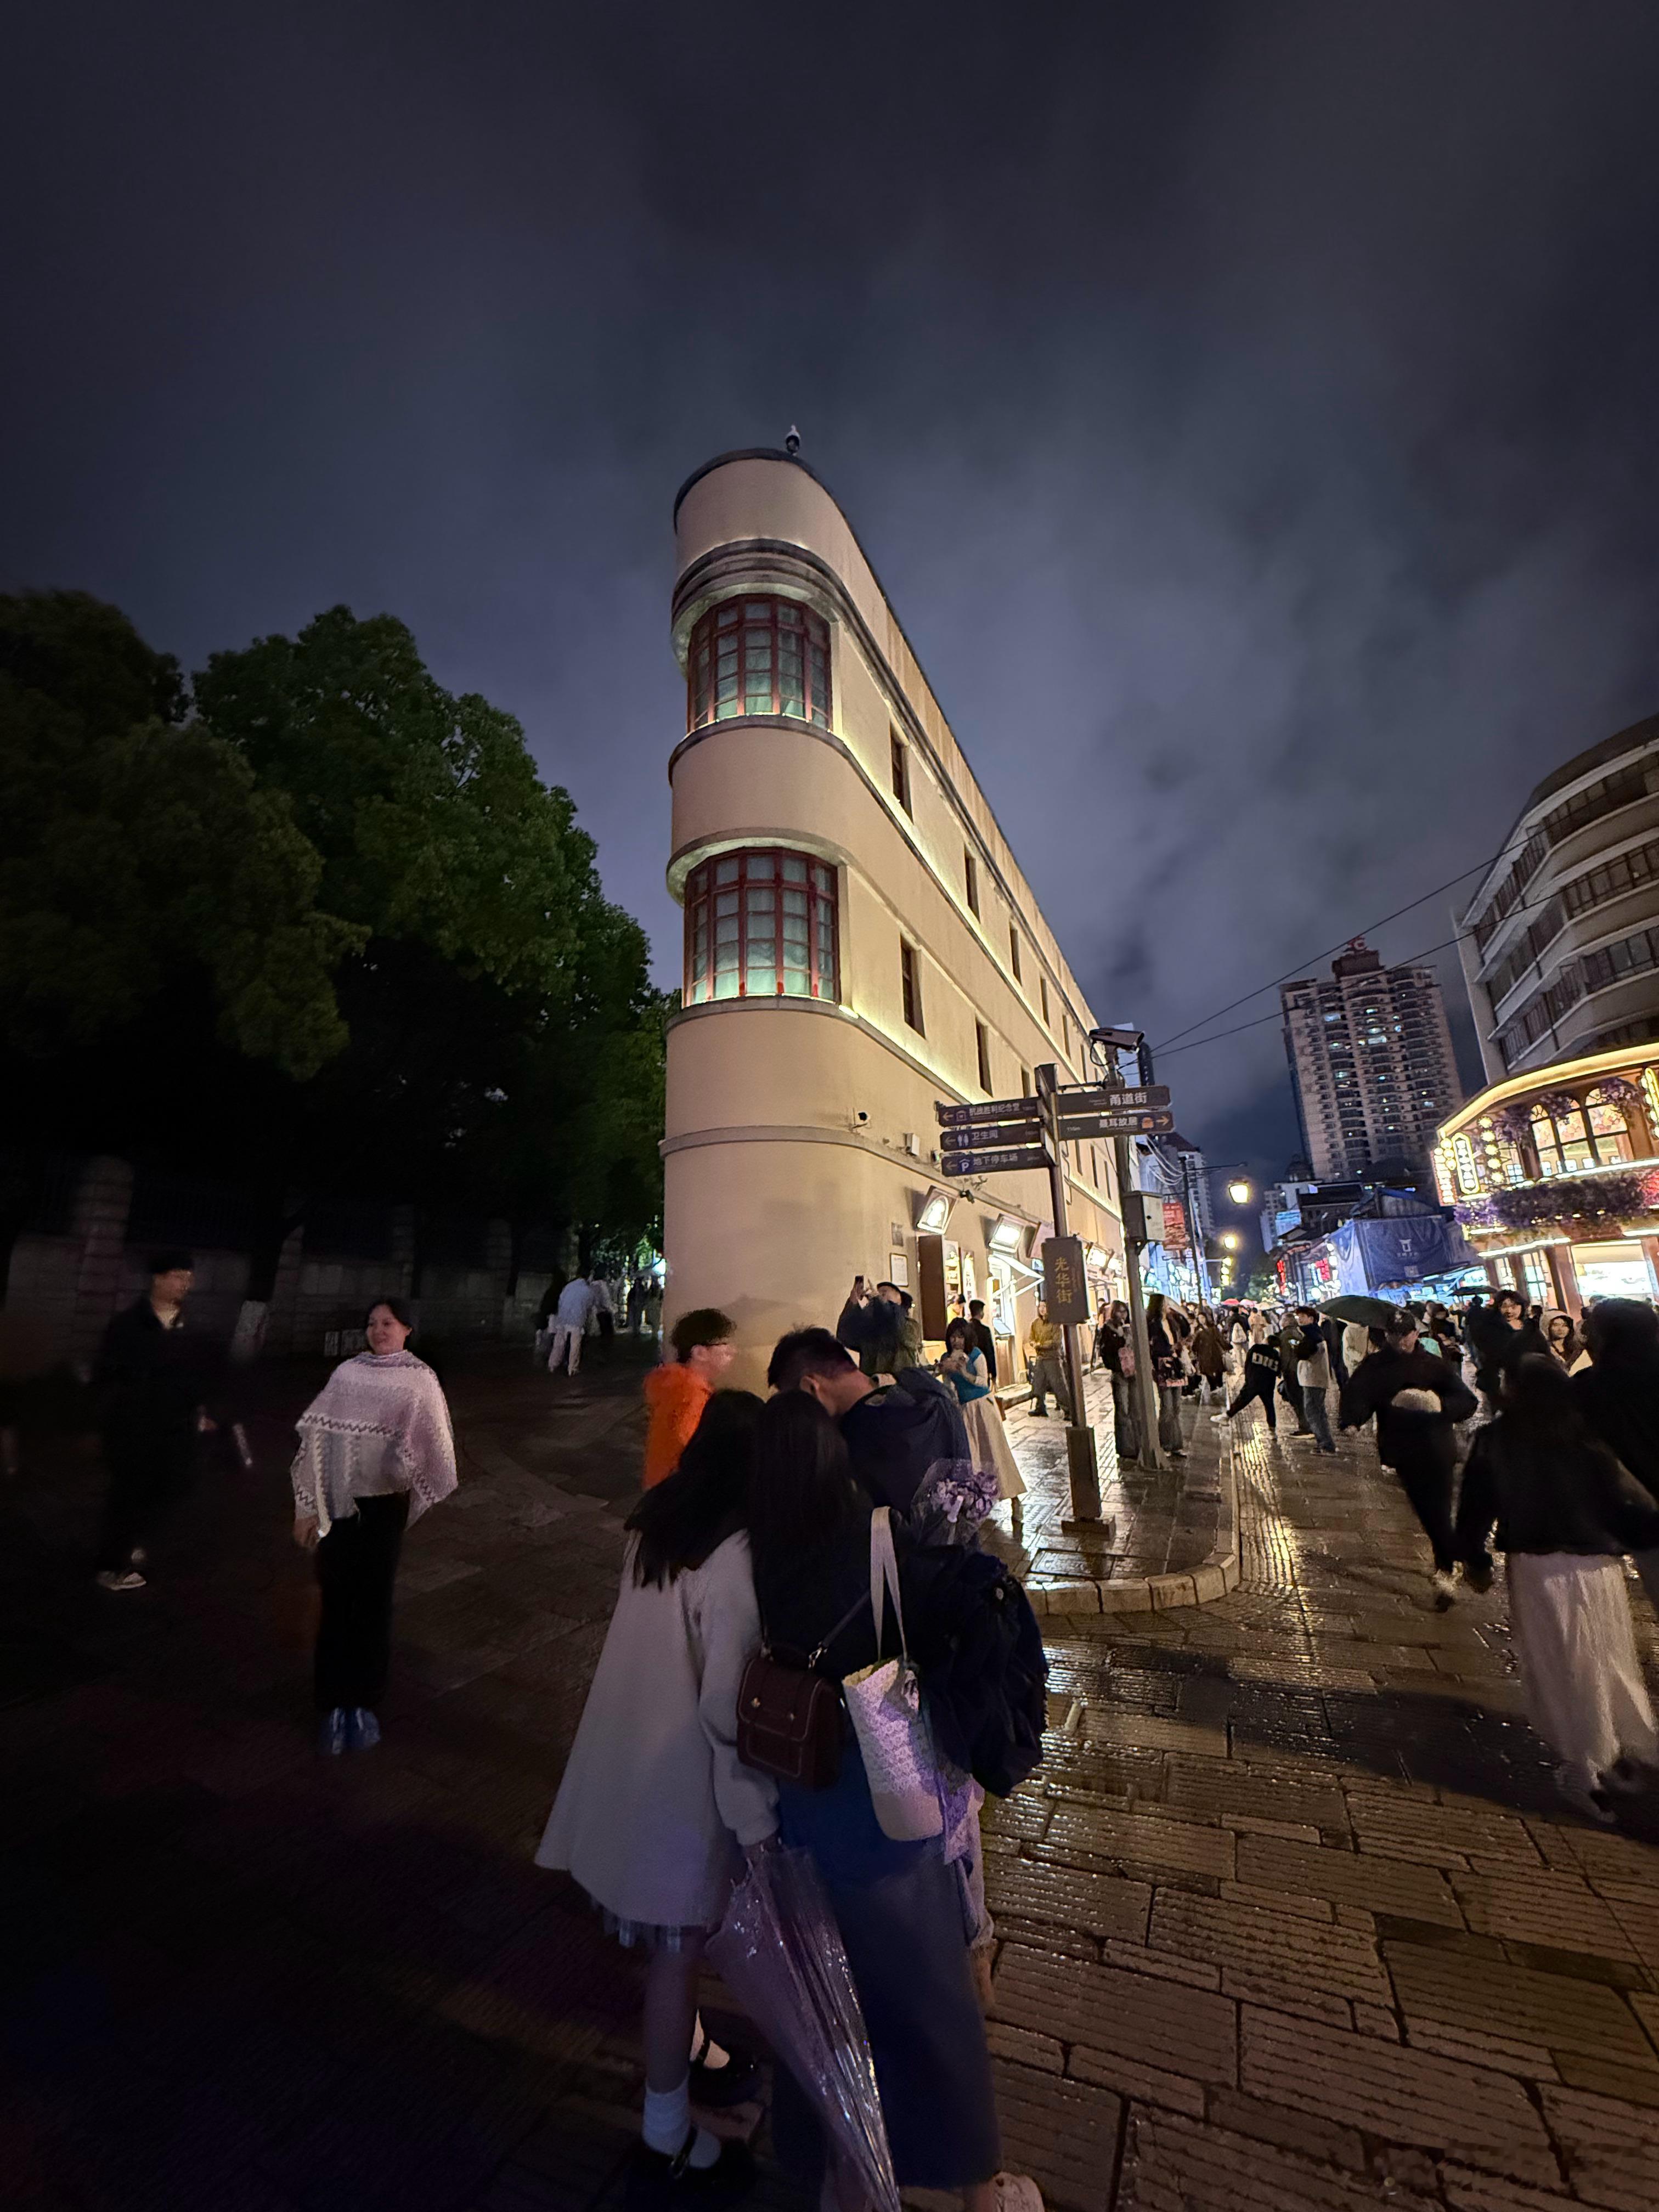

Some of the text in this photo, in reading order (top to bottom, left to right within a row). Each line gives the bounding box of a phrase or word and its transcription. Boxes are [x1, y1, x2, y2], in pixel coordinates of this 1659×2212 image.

[1110, 1092, 1147, 1106] 甬道街
[969, 1103, 1020, 1116] 抗战胜利纪念堂
[1099, 1116, 1138, 1128] 聂耳故居
[972, 1130, 998, 1141] 卫生间
[973, 1153, 1018, 1166] 地下停车场
[961, 1163, 969, 1172] P
[1054, 1257, 1073, 1304] 光华街
